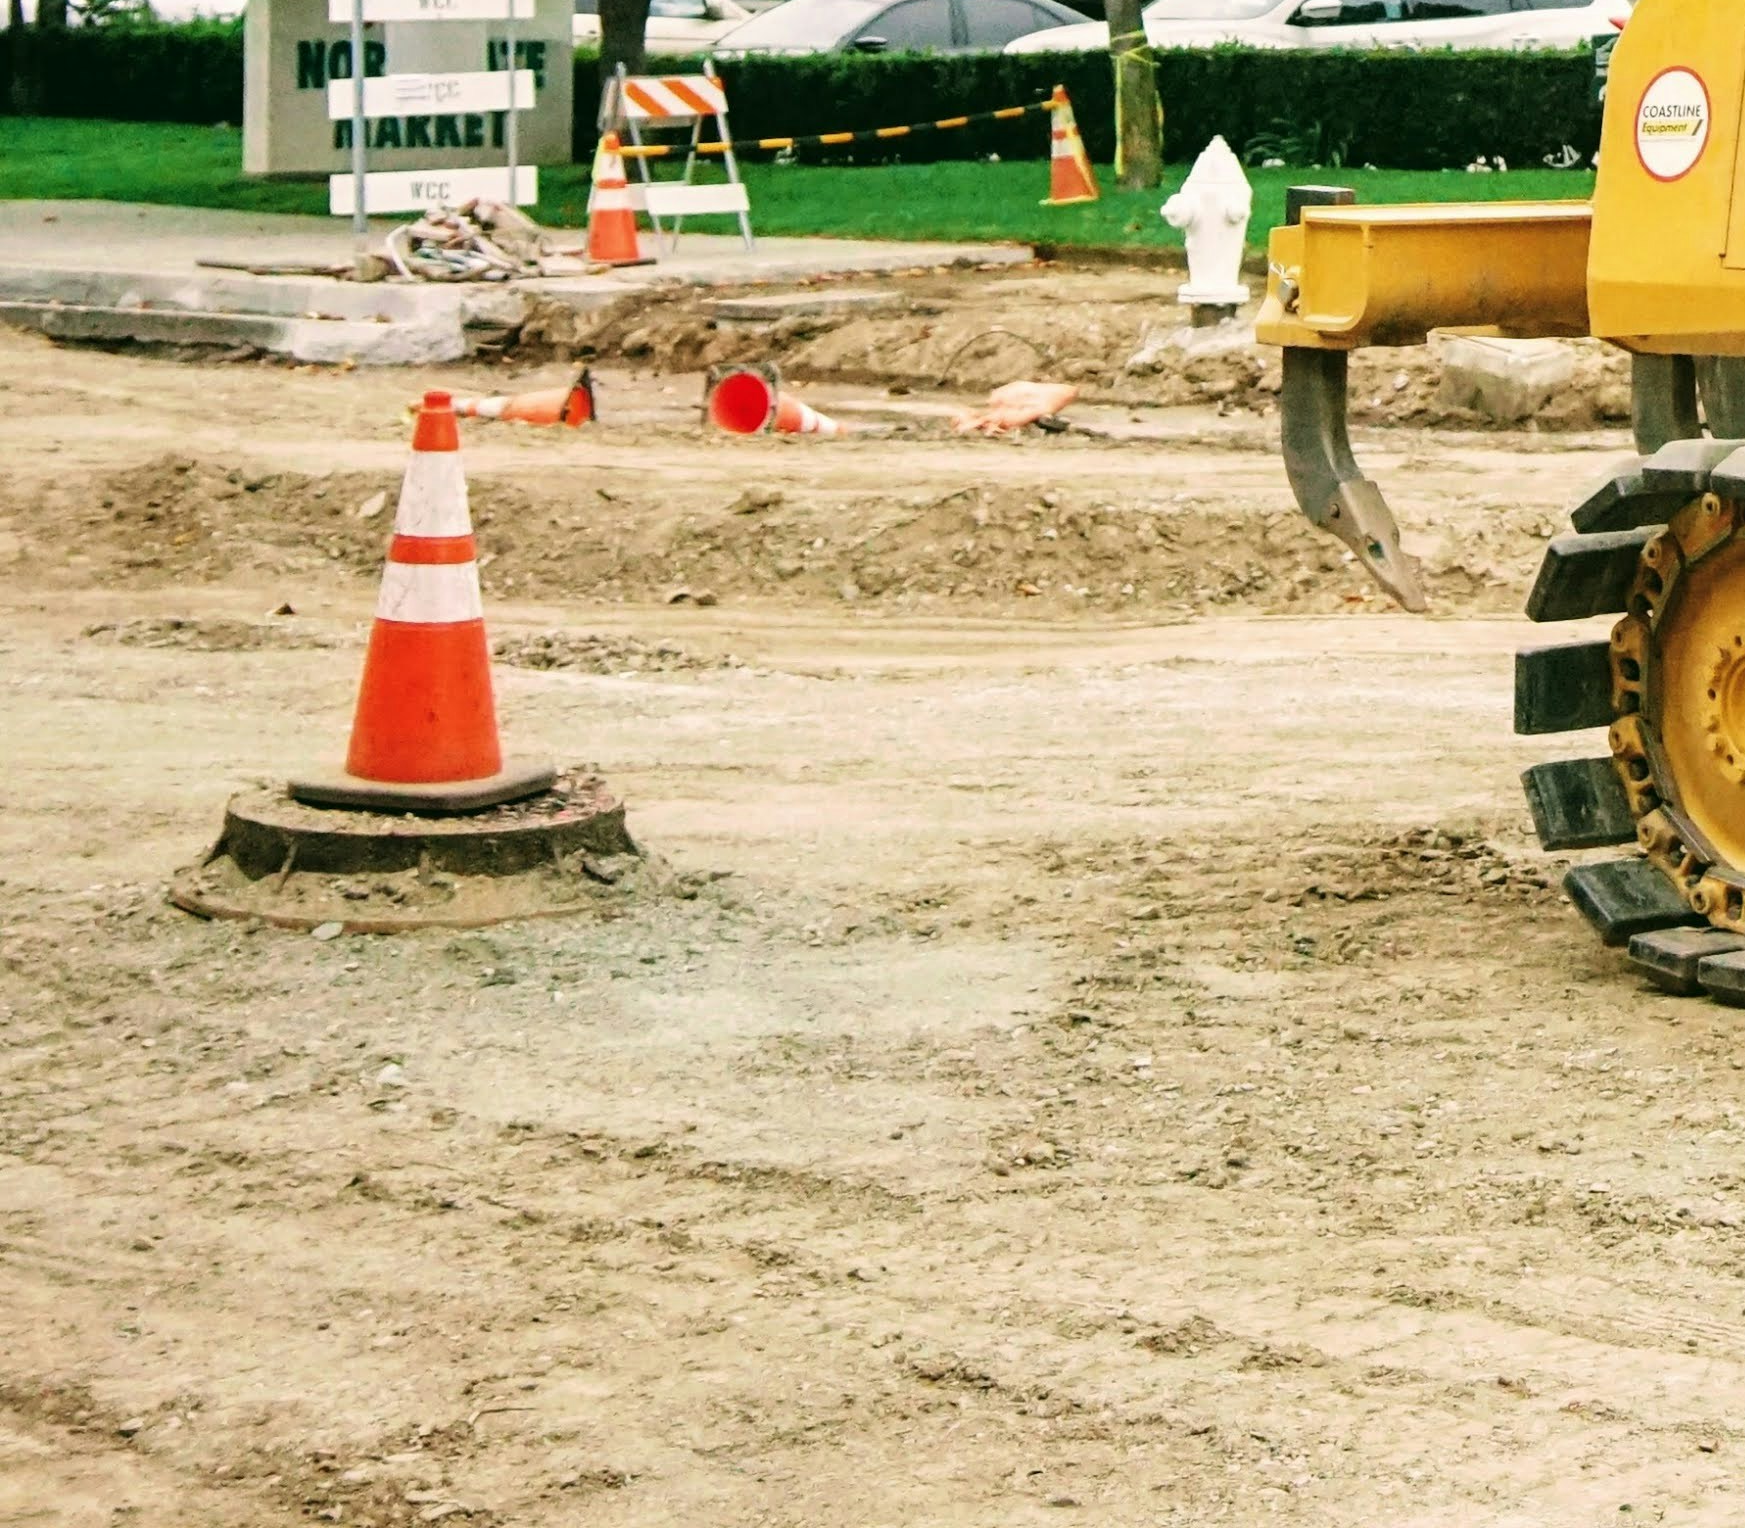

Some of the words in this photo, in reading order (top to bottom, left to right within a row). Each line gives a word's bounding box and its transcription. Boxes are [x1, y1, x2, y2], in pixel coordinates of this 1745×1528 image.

[1642, 104, 1702, 118] COASTLINE
[1641, 121, 1688, 137] Equipment
[410, 180, 450, 200] WCC
